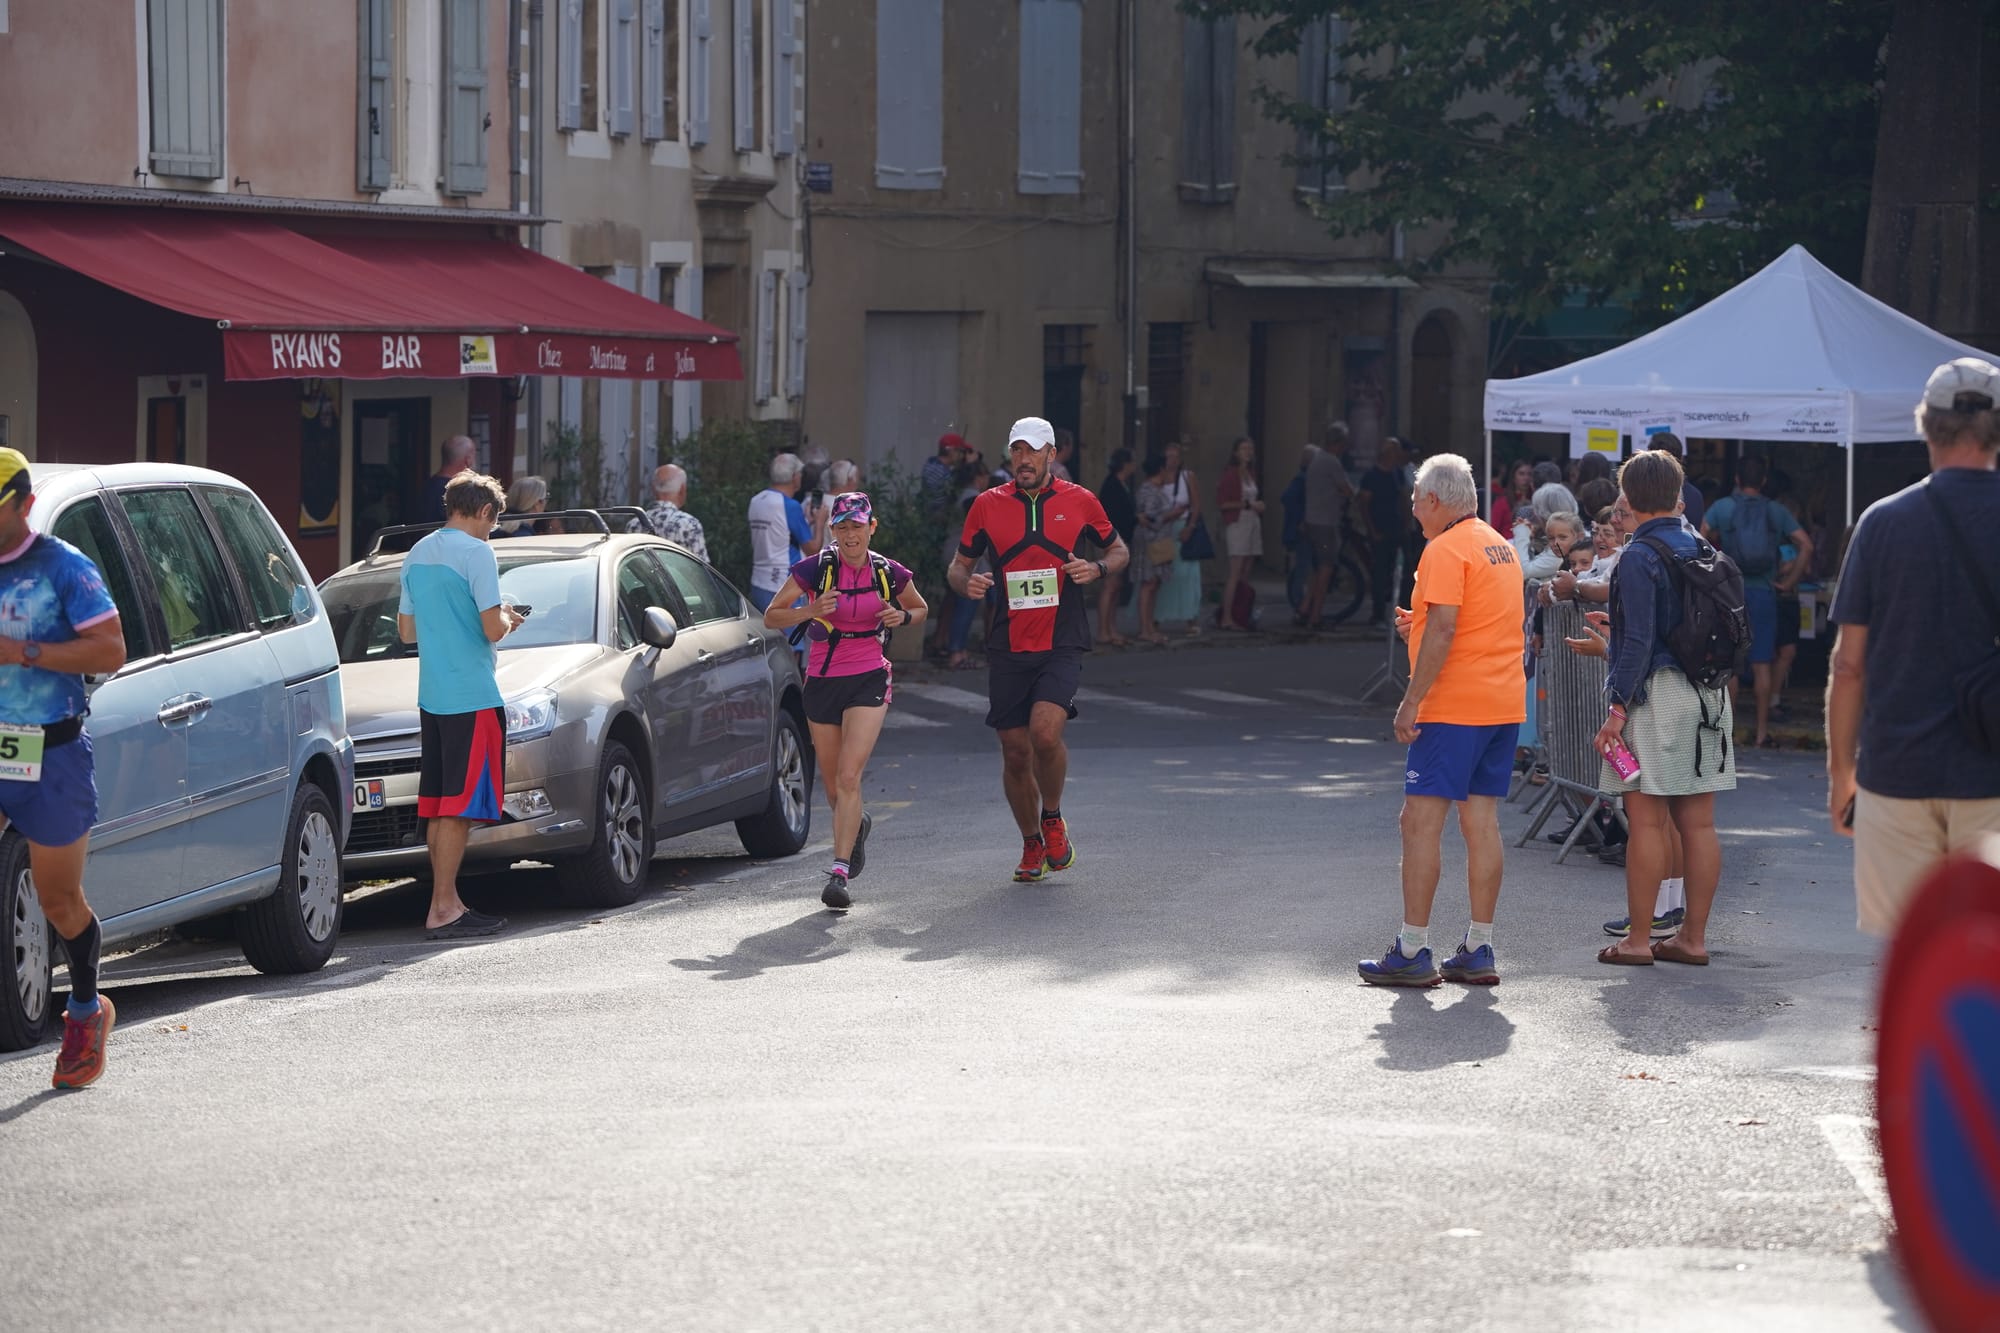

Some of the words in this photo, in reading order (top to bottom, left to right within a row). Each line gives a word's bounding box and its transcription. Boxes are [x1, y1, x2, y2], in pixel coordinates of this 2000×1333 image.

[270, 333, 342, 369] RYAN'S
[381, 335, 422, 369] BAR
[538, 339, 563, 368] Chez
[589, 345, 628, 371] Martine
[646, 352, 655, 372] et
[674, 347, 696, 378] John
[1484, 545, 1516, 565] STAFF
[1019, 580, 1044, 596] 15
[371, 794, 382, 806] 48
